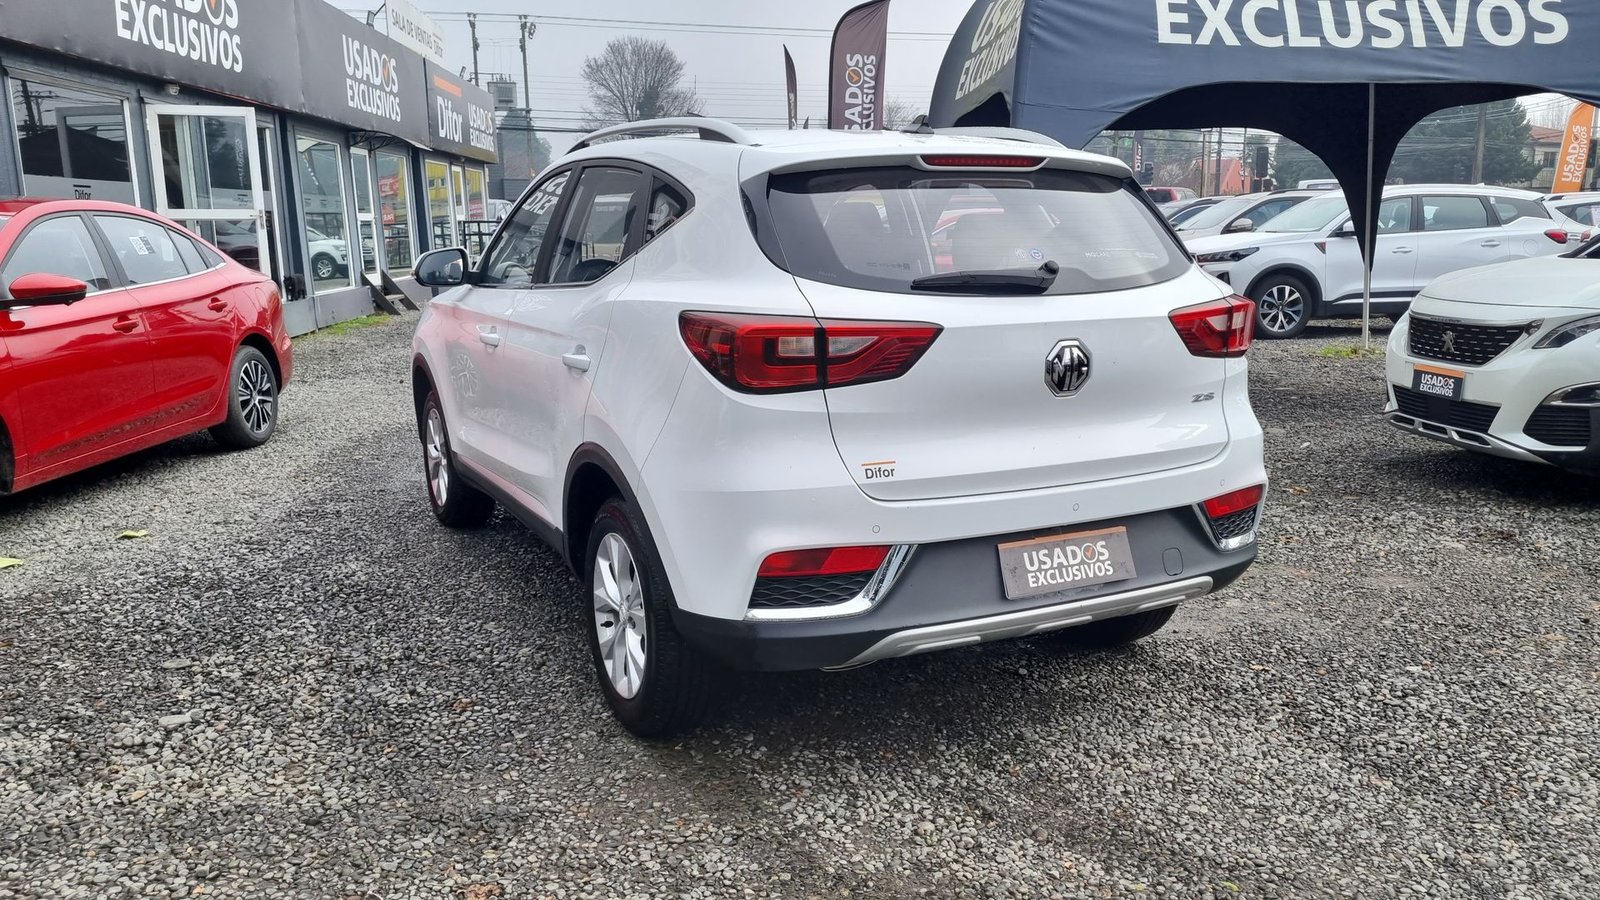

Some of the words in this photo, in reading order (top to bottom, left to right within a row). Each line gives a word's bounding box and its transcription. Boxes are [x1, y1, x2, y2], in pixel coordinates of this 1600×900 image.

[115, 0, 243, 73] EXCLUSIVOS
[391, 9, 406, 33] SALA
[406, 18, 414, 38] DE
[413, 24, 433, 49] VENTAS
[1156, 0, 1569, 48] EXCLUSIVOS
[342, 33, 399, 93] USADOS
[346, 78, 401, 122] EXCLUSIVOS
[467, 102, 493, 134] USADOS
[436, 95, 463, 143] Difor
[469, 129, 495, 152] EXCLUSIVOS
[1561, 124, 1581, 182] USADOS
[1572, 125, 1588, 183] EXCLUSIVOS
[74, 189, 91, 200] Difor
[1051, 346, 1089, 392] MG
[1421, 373, 1455, 389] USADOS
[1191, 392, 1216, 403] ZS
[1419, 383, 1453, 397] EXCLUSIVOS
[864, 466, 896, 479] Difor
[1023, 540, 1109, 571] USADOS
[1027, 560, 1114, 588] EXCLUSIVOS
